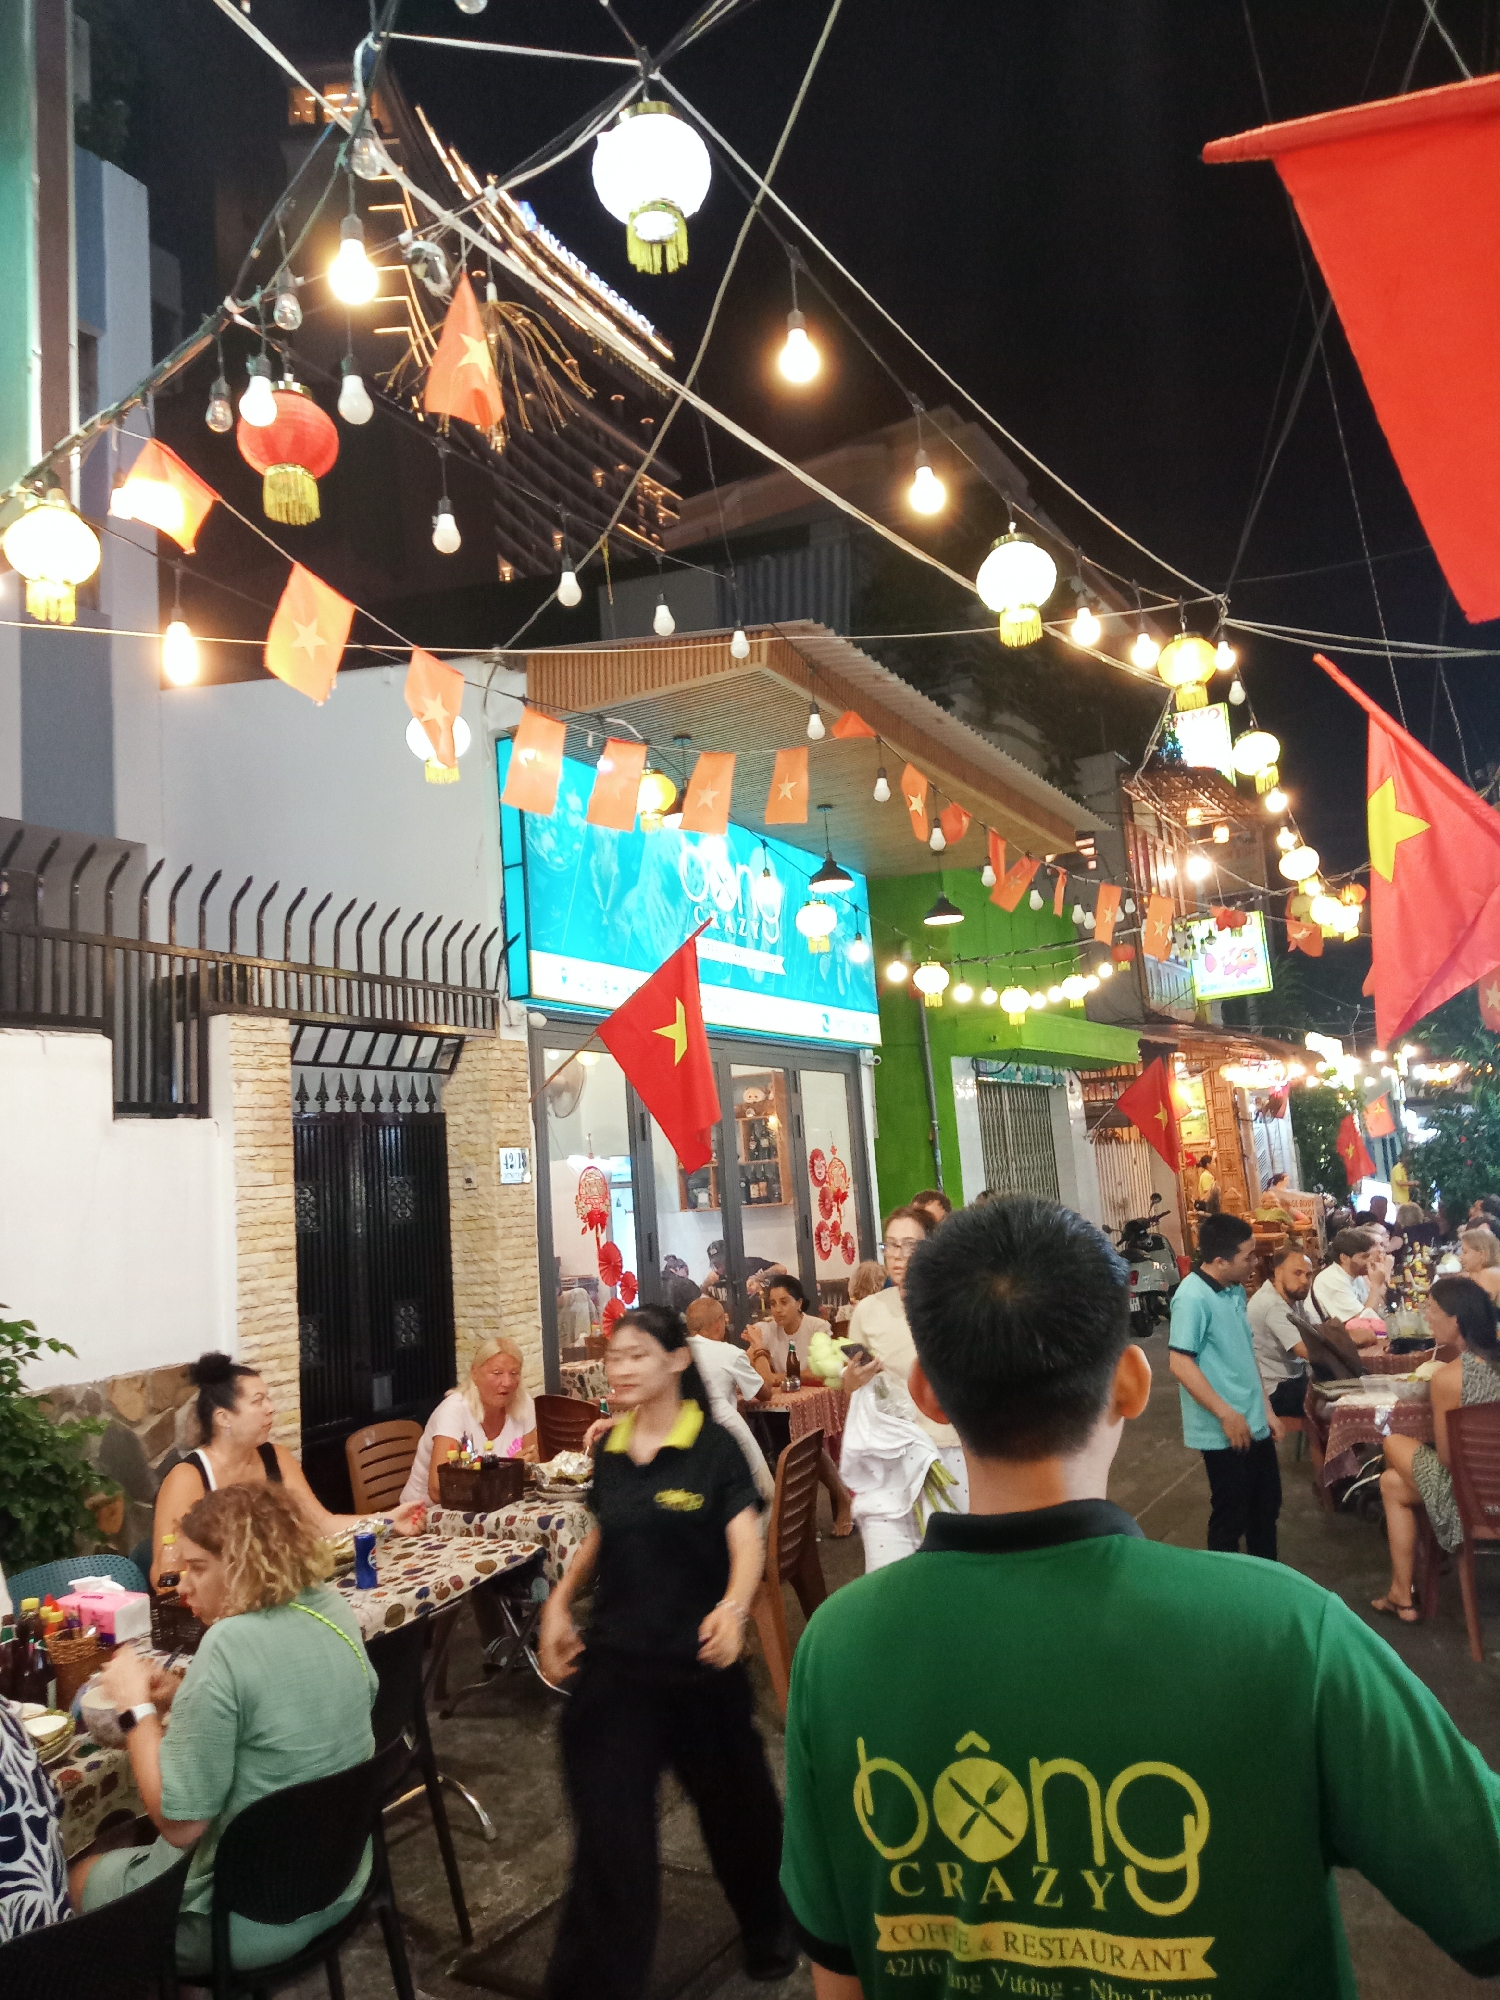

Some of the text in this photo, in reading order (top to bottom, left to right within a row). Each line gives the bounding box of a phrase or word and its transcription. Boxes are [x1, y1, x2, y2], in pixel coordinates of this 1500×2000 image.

[693, 904, 760, 940] CRAZY
[889, 1861, 1115, 1912] CRAZY
[889, 1922, 970, 1956] COFFE
[1003, 1930, 1193, 1973] RESTAURANT
